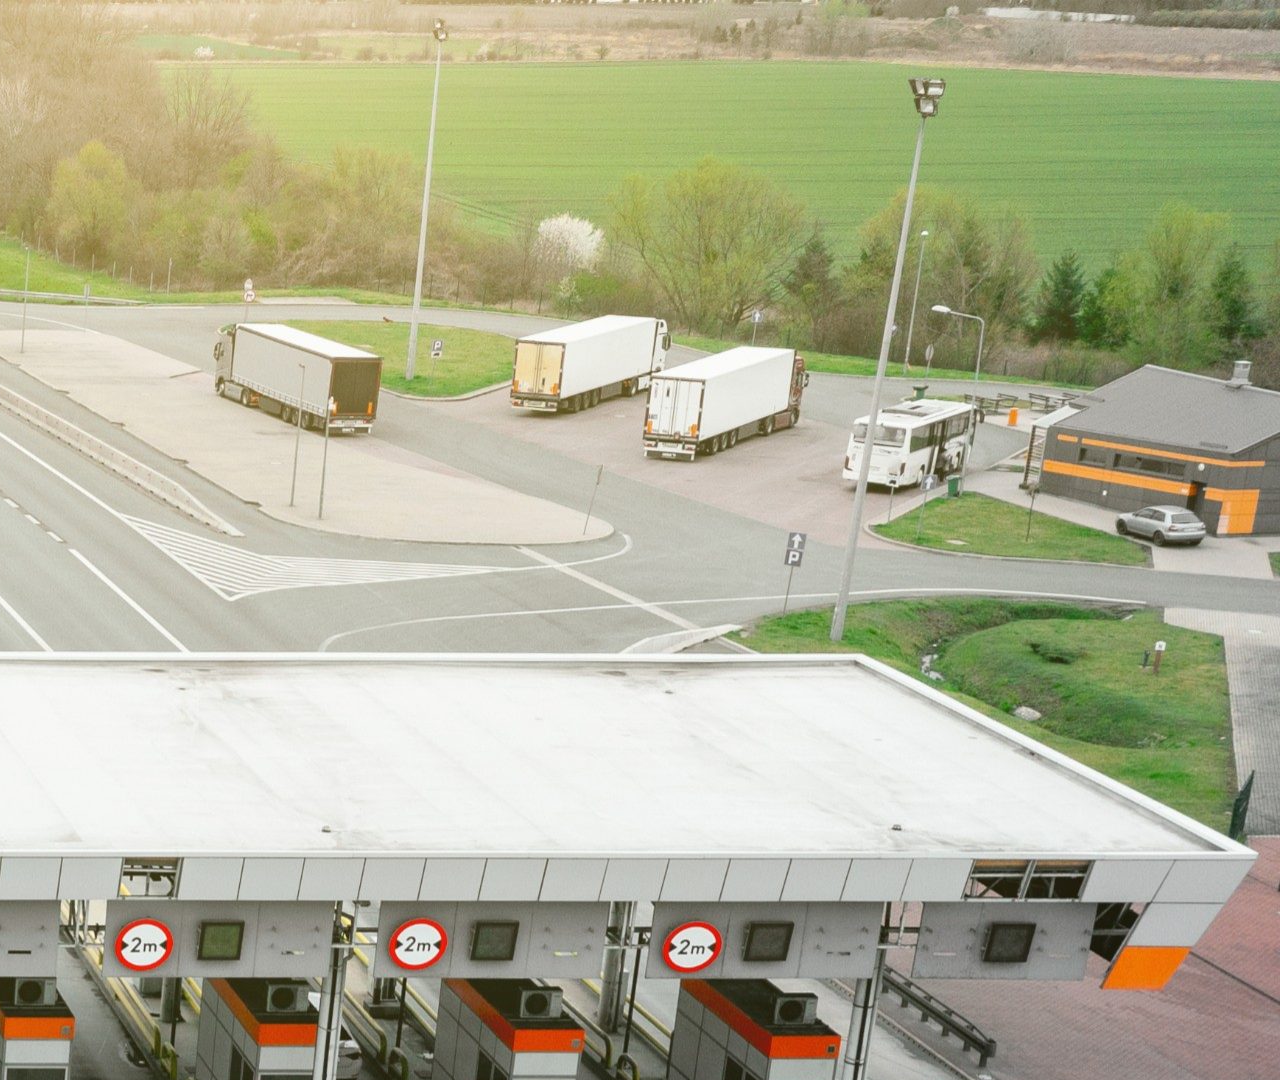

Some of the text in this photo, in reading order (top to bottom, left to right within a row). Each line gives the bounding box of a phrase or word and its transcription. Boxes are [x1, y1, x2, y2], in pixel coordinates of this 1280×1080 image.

[435, 341, 442, 351] P
[788, 551, 800, 564] P
[130, 937, 157, 953] 2m
[404, 936, 431, 952] 2m
[678, 939, 705, 955] 2m
